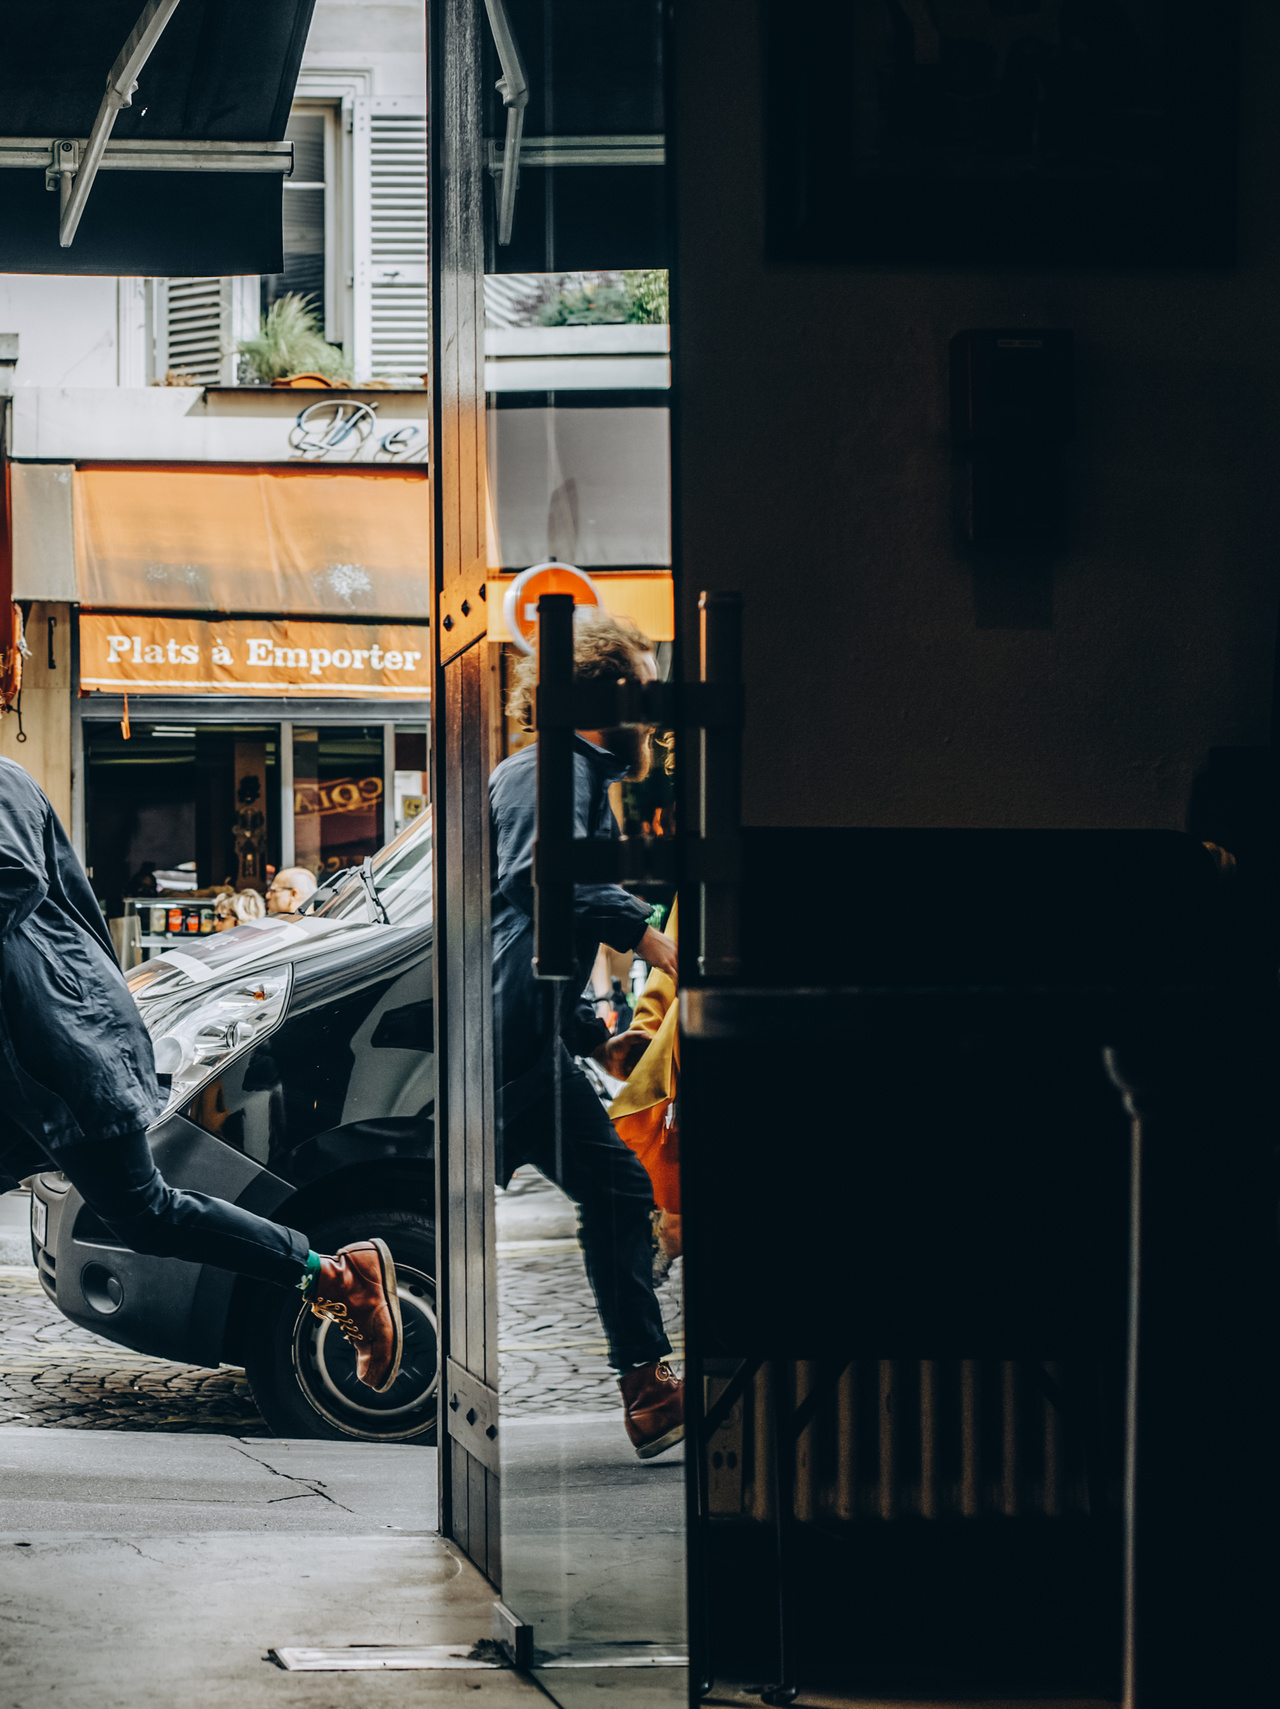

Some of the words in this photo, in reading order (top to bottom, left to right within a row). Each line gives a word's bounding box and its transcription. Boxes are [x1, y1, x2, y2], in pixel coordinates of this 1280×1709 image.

[106, 635, 200, 665] Plats
[211, 638, 234, 666] à
[246, 638, 422, 675] Emporter
